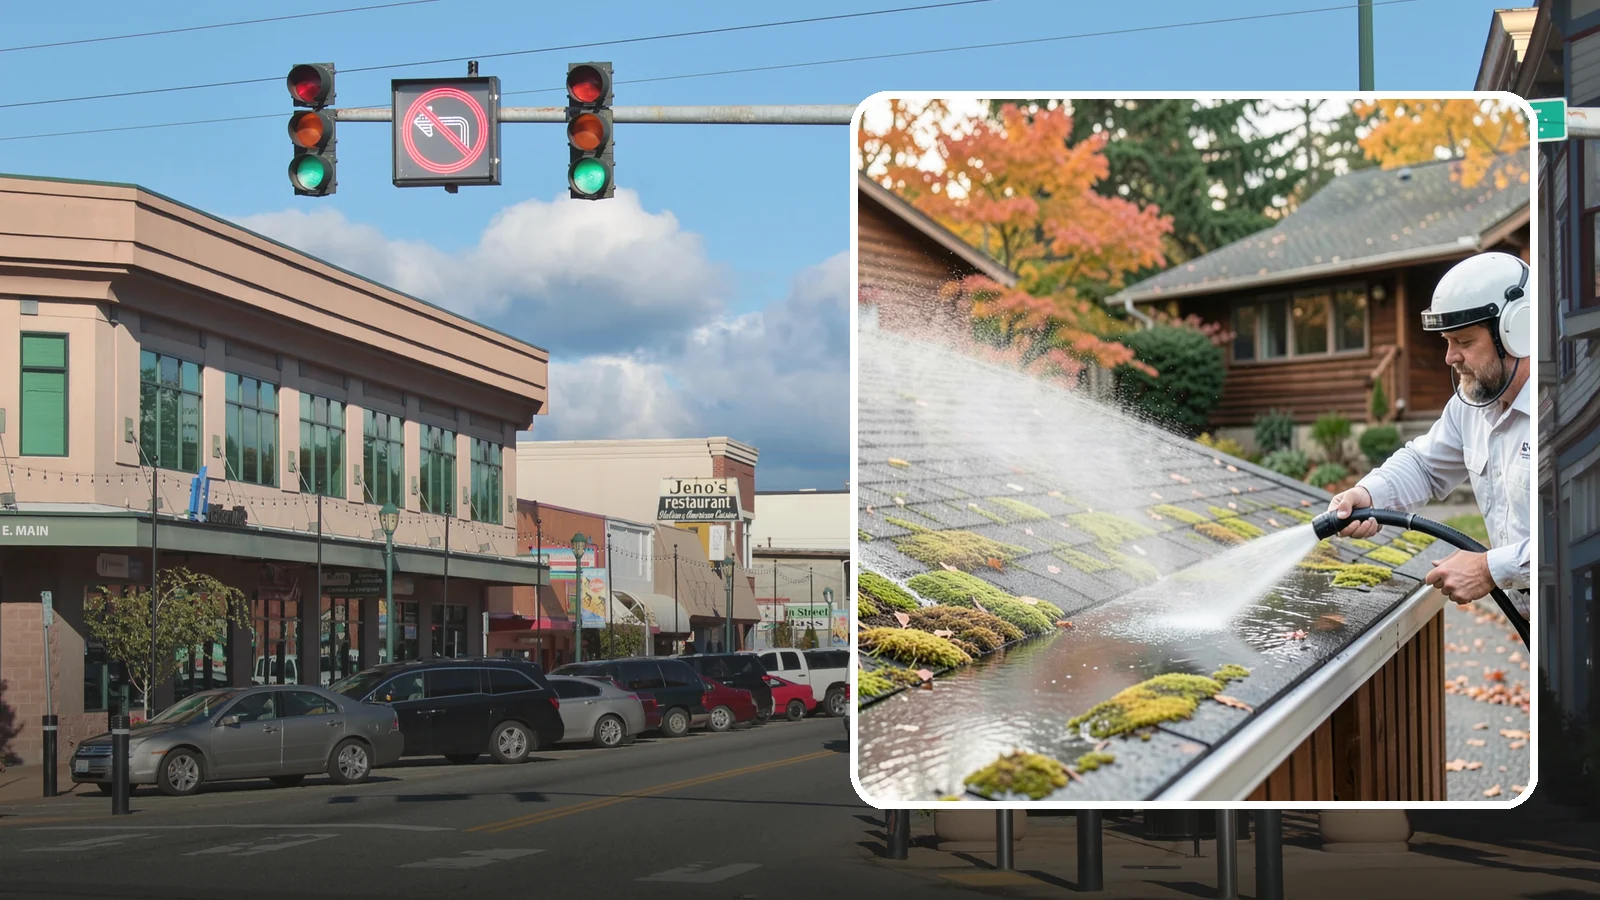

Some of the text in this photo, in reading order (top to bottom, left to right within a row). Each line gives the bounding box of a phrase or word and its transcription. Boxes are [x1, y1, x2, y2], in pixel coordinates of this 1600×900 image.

[670, 480, 727, 494] Jeno's
[665, 497, 731, 509] restaurant
[659, 510, 681, 519] Italian
[686, 510, 714, 519] American
[715, 510, 737, 519] Cuisine
[2, 525, 49, 536] E. MAIN
[785, 608, 795, 616] in
[798, 608, 828, 616] Street
[791, 619, 823, 627] lass
